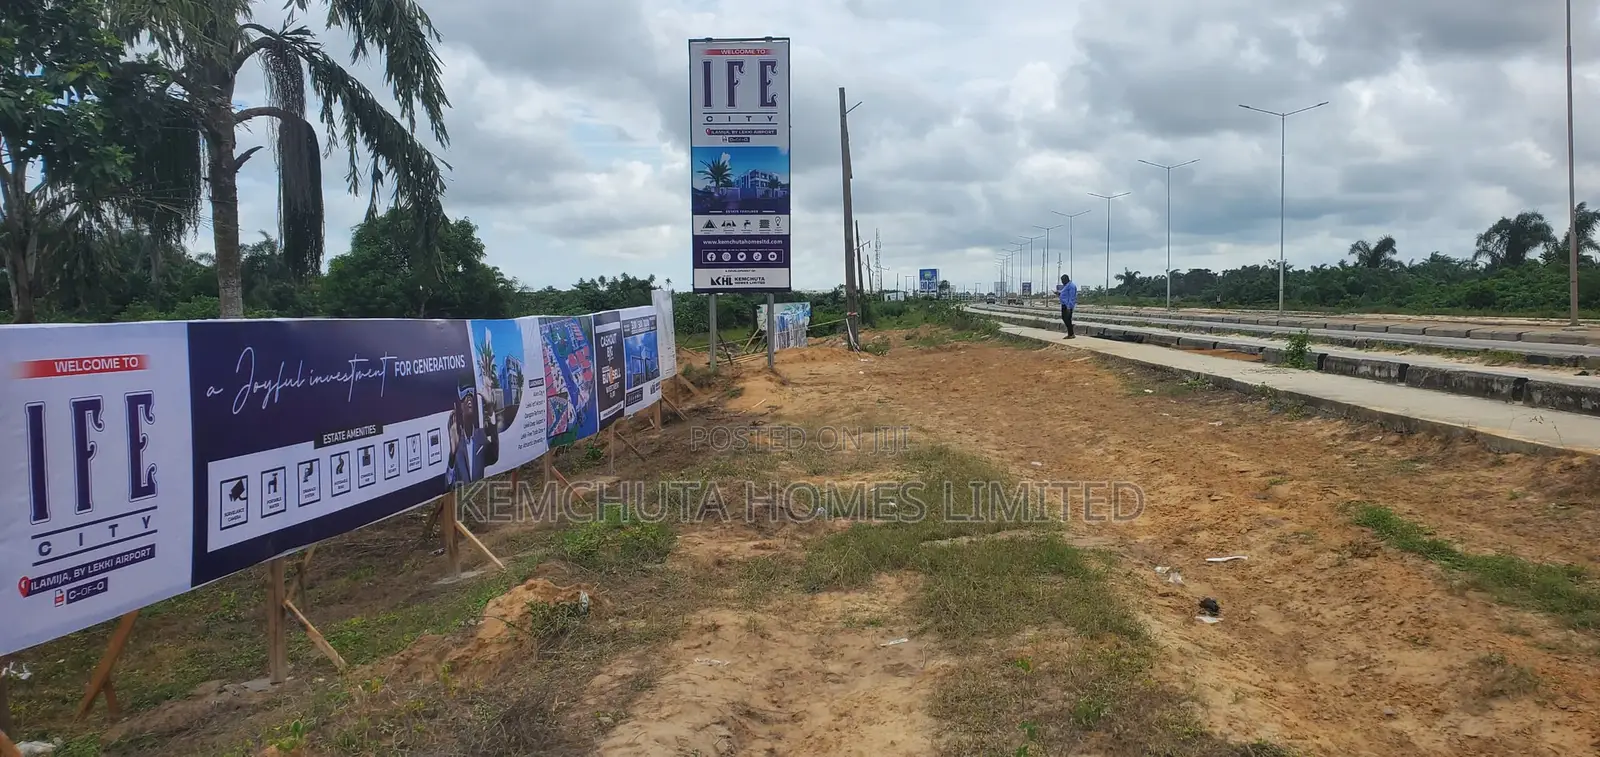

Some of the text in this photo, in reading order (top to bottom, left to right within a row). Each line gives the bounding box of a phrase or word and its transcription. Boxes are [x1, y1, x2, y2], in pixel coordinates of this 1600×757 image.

[702, 59, 778, 109] IFE
[702, 238, 783, 246] www.kemchutahomesltd.com
[54, 356, 139, 373] WELCOME TO
[232, 346, 305, 415] Joyful
[309, 351, 398, 403] investment
[394, 359, 412, 377] FOR
[412, 354, 466, 375] GENERATIONS
[322, 424, 377, 445] ESTATE AMENITIES
[25, 390, 158, 525] IFE
[38, 515, 152, 557] CITY
[30, 546, 152, 591] ILAMIJA, BY LEKKI AIRPORT
[68, 581, 105, 599] C-OF-O
